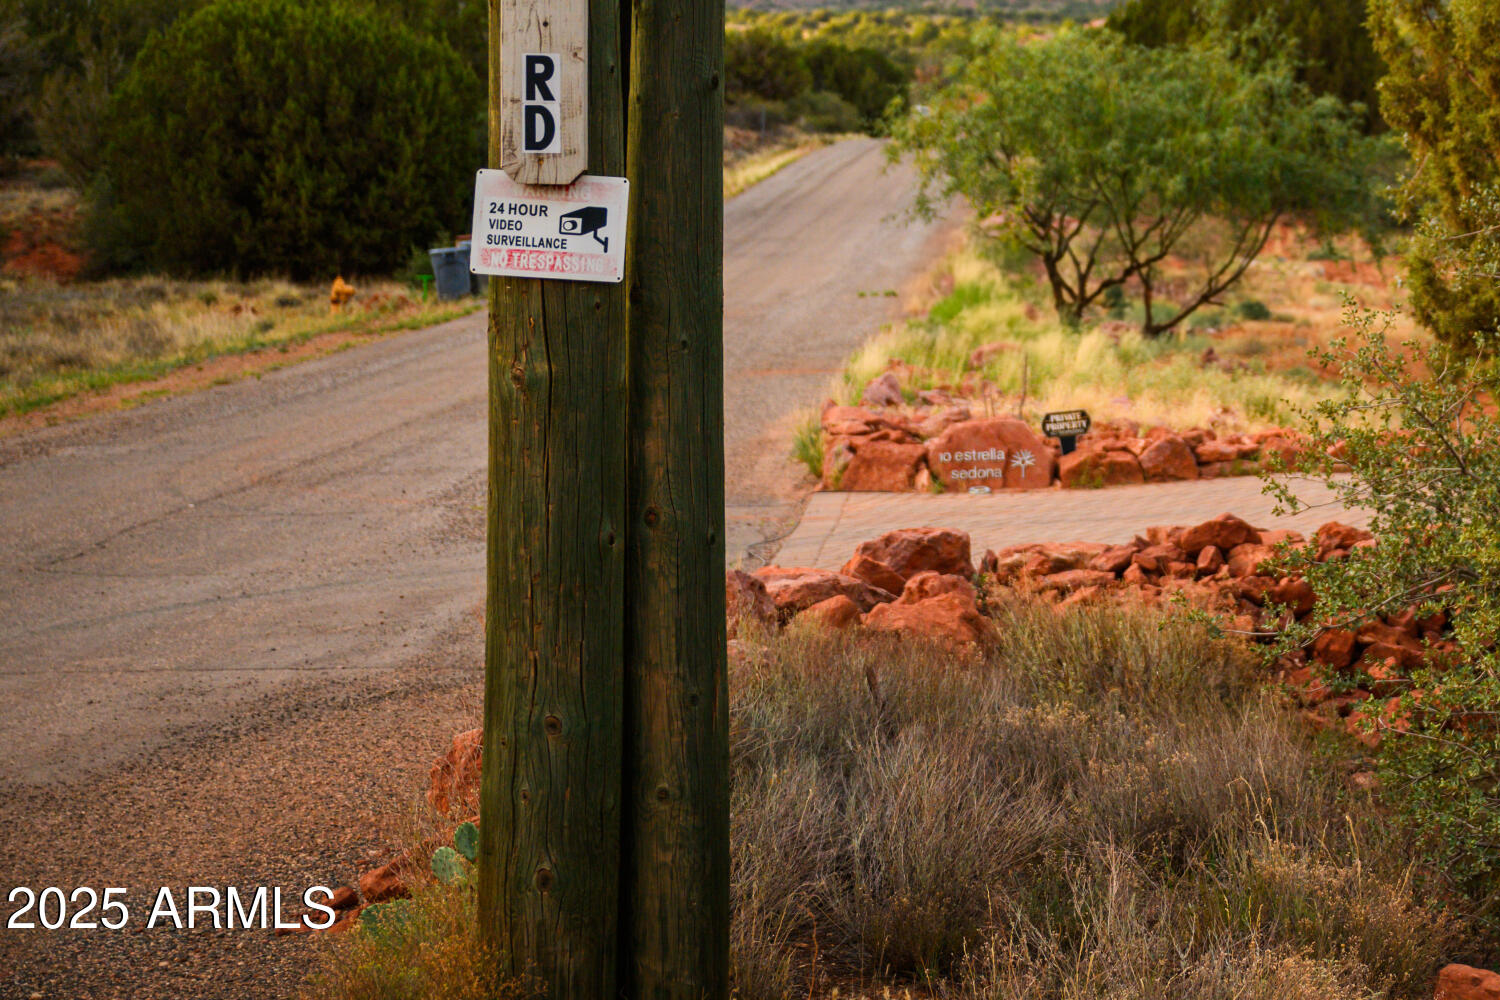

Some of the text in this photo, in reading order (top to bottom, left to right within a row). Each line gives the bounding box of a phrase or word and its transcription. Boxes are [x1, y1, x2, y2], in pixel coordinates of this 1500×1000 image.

[525, 54, 558, 152] RD
[489, 202, 548, 217] 24 HOUR
[489, 218, 523, 231] VIDEO
[486, 233, 568, 250] SURVEILLANCE
[490, 252, 604, 274] NO TRESPASSING
[1050, 412, 1082, 423] PRIVATE
[1045, 420, 1088, 432] PROPERTY
[954, 447, 1005, 463] estrella
[951, 466, 1003, 481] sedona
